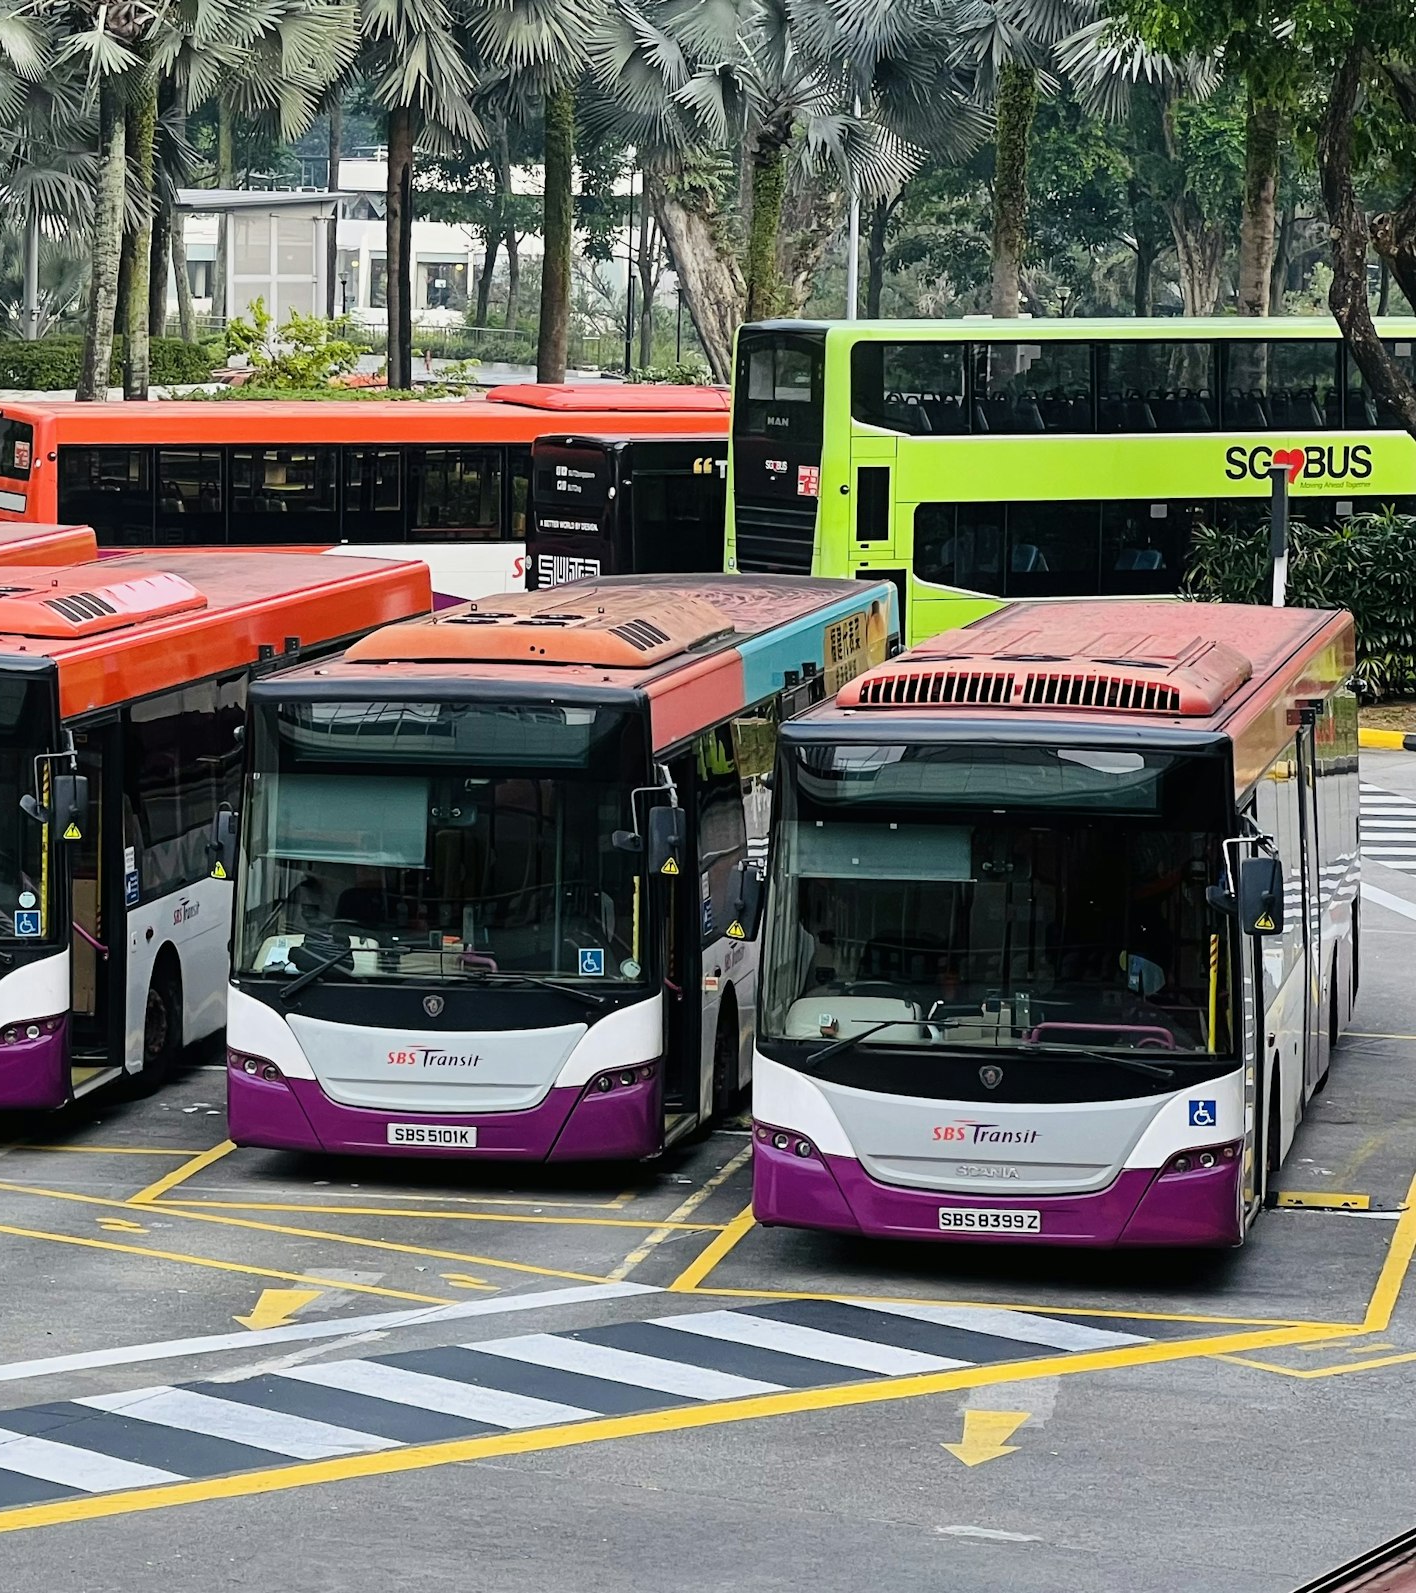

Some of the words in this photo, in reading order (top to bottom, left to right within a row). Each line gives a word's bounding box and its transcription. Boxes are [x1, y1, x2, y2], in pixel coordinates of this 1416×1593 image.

[767, 416, 789, 427] MAN
[1324, 481, 1344, 489] Ahead
[387, 1051, 416, 1065] SBS
[416, 1049, 484, 1068] Transit
[932, 1126, 966, 1141] SBS
[965, 1124, 1043, 1145] Transit
[955, 1165, 1020, 1179] SCANIA
